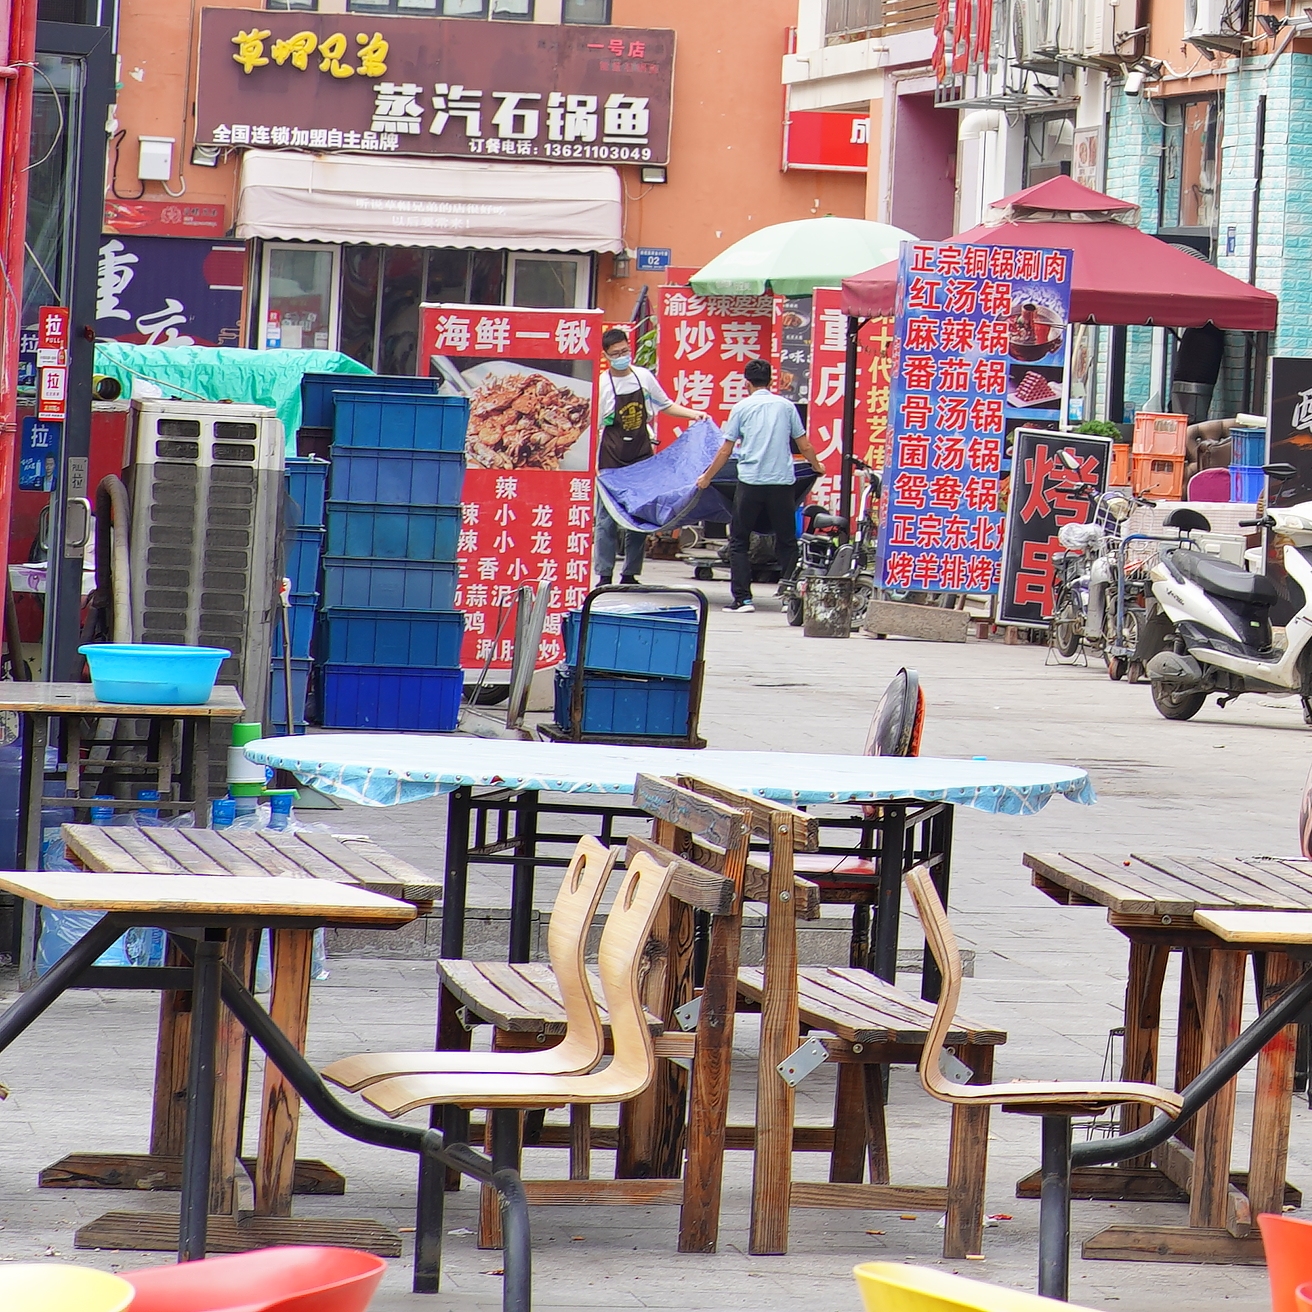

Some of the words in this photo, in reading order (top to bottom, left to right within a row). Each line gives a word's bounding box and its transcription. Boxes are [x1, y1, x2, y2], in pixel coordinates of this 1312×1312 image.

[231, 27, 390, 79] 草帽兄弟
[586, 39, 646, 59] 一号店
[370, 81, 651, 145] 蒸汽石锅鱼
[211, 124, 400, 151] 全国连锁加盟自主品牌
[647, 255, 661, 266] 02
[909, 244, 1066, 283] 正宗铜锅涮肉
[908, 278, 1012, 317] 红汤锅
[45, 314, 62, 336] 拉
[673, 319, 762, 363] 炒菜
[904, 317, 1009, 356] 麻辣锅
[47, 371, 60, 389] 拉
[901, 356, 1006, 394] 番茄锅
[900, 395, 1004, 433] 骨汤锅
[30, 423, 49, 448] 拉
[897, 434, 1001, 472] 菌汤锅
[893, 474, 997, 513] 鸳鸯锅
